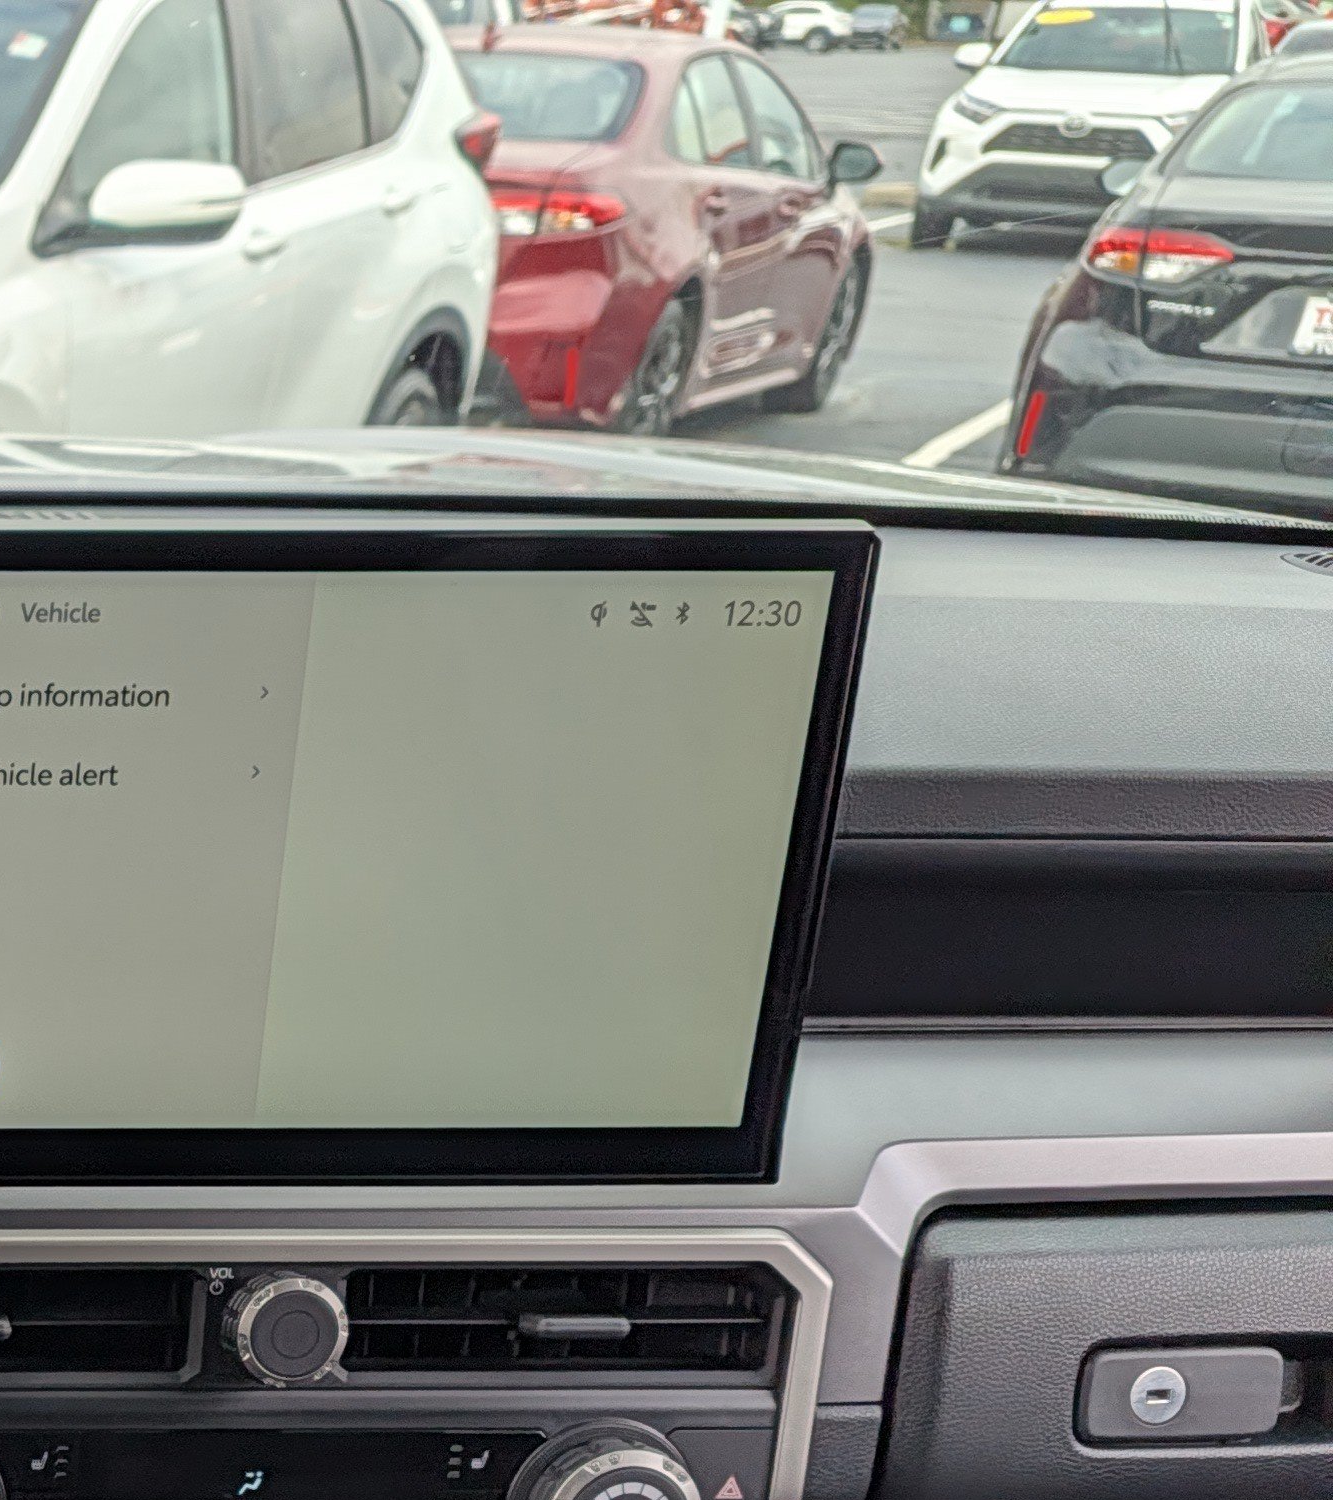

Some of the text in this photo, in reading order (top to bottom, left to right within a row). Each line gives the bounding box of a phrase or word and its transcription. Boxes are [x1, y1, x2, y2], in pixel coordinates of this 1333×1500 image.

[21, 602, 101, 623] Vehicle
[725, 600, 802, 627] 12:30
[19, 682, 170, 707] information
[59, 762, 119, 786] alert
[209, 1267, 235, 1279] VOL
